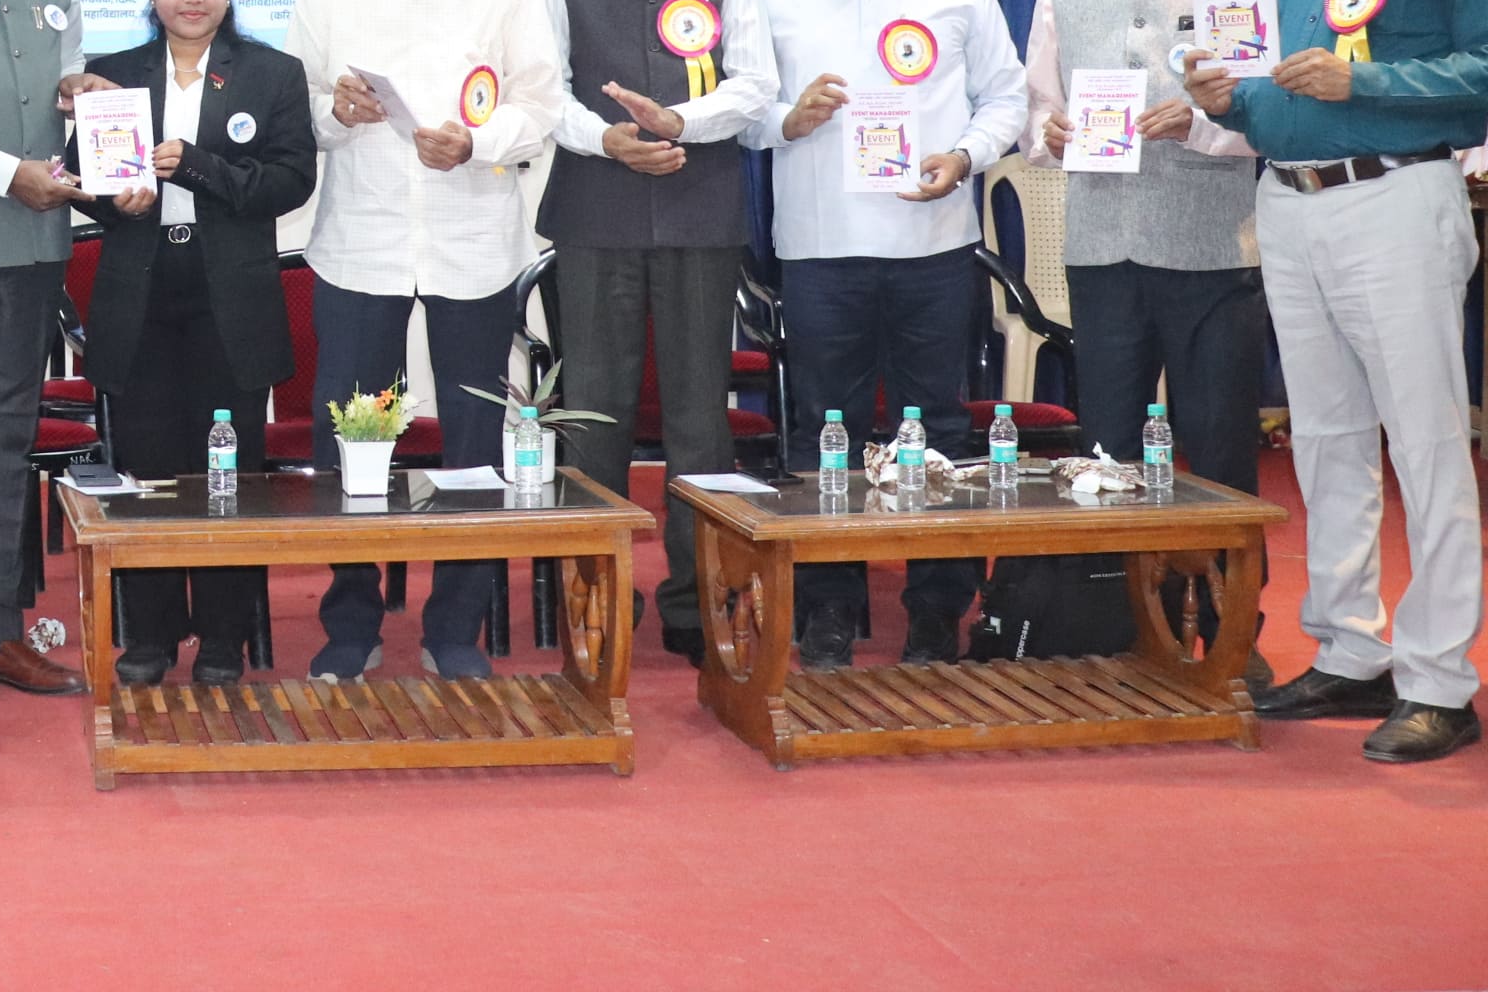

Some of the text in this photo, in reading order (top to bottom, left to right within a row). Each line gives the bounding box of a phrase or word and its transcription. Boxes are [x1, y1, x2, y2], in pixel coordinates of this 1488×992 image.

[1218, 14, 1251, 24] EVENT
[1091, 116, 1123, 124] EVENT
[101, 136, 131, 145] EVENT
[866, 134, 897, 143] EVENT
[1015, 619, 1031, 660] ppercase
